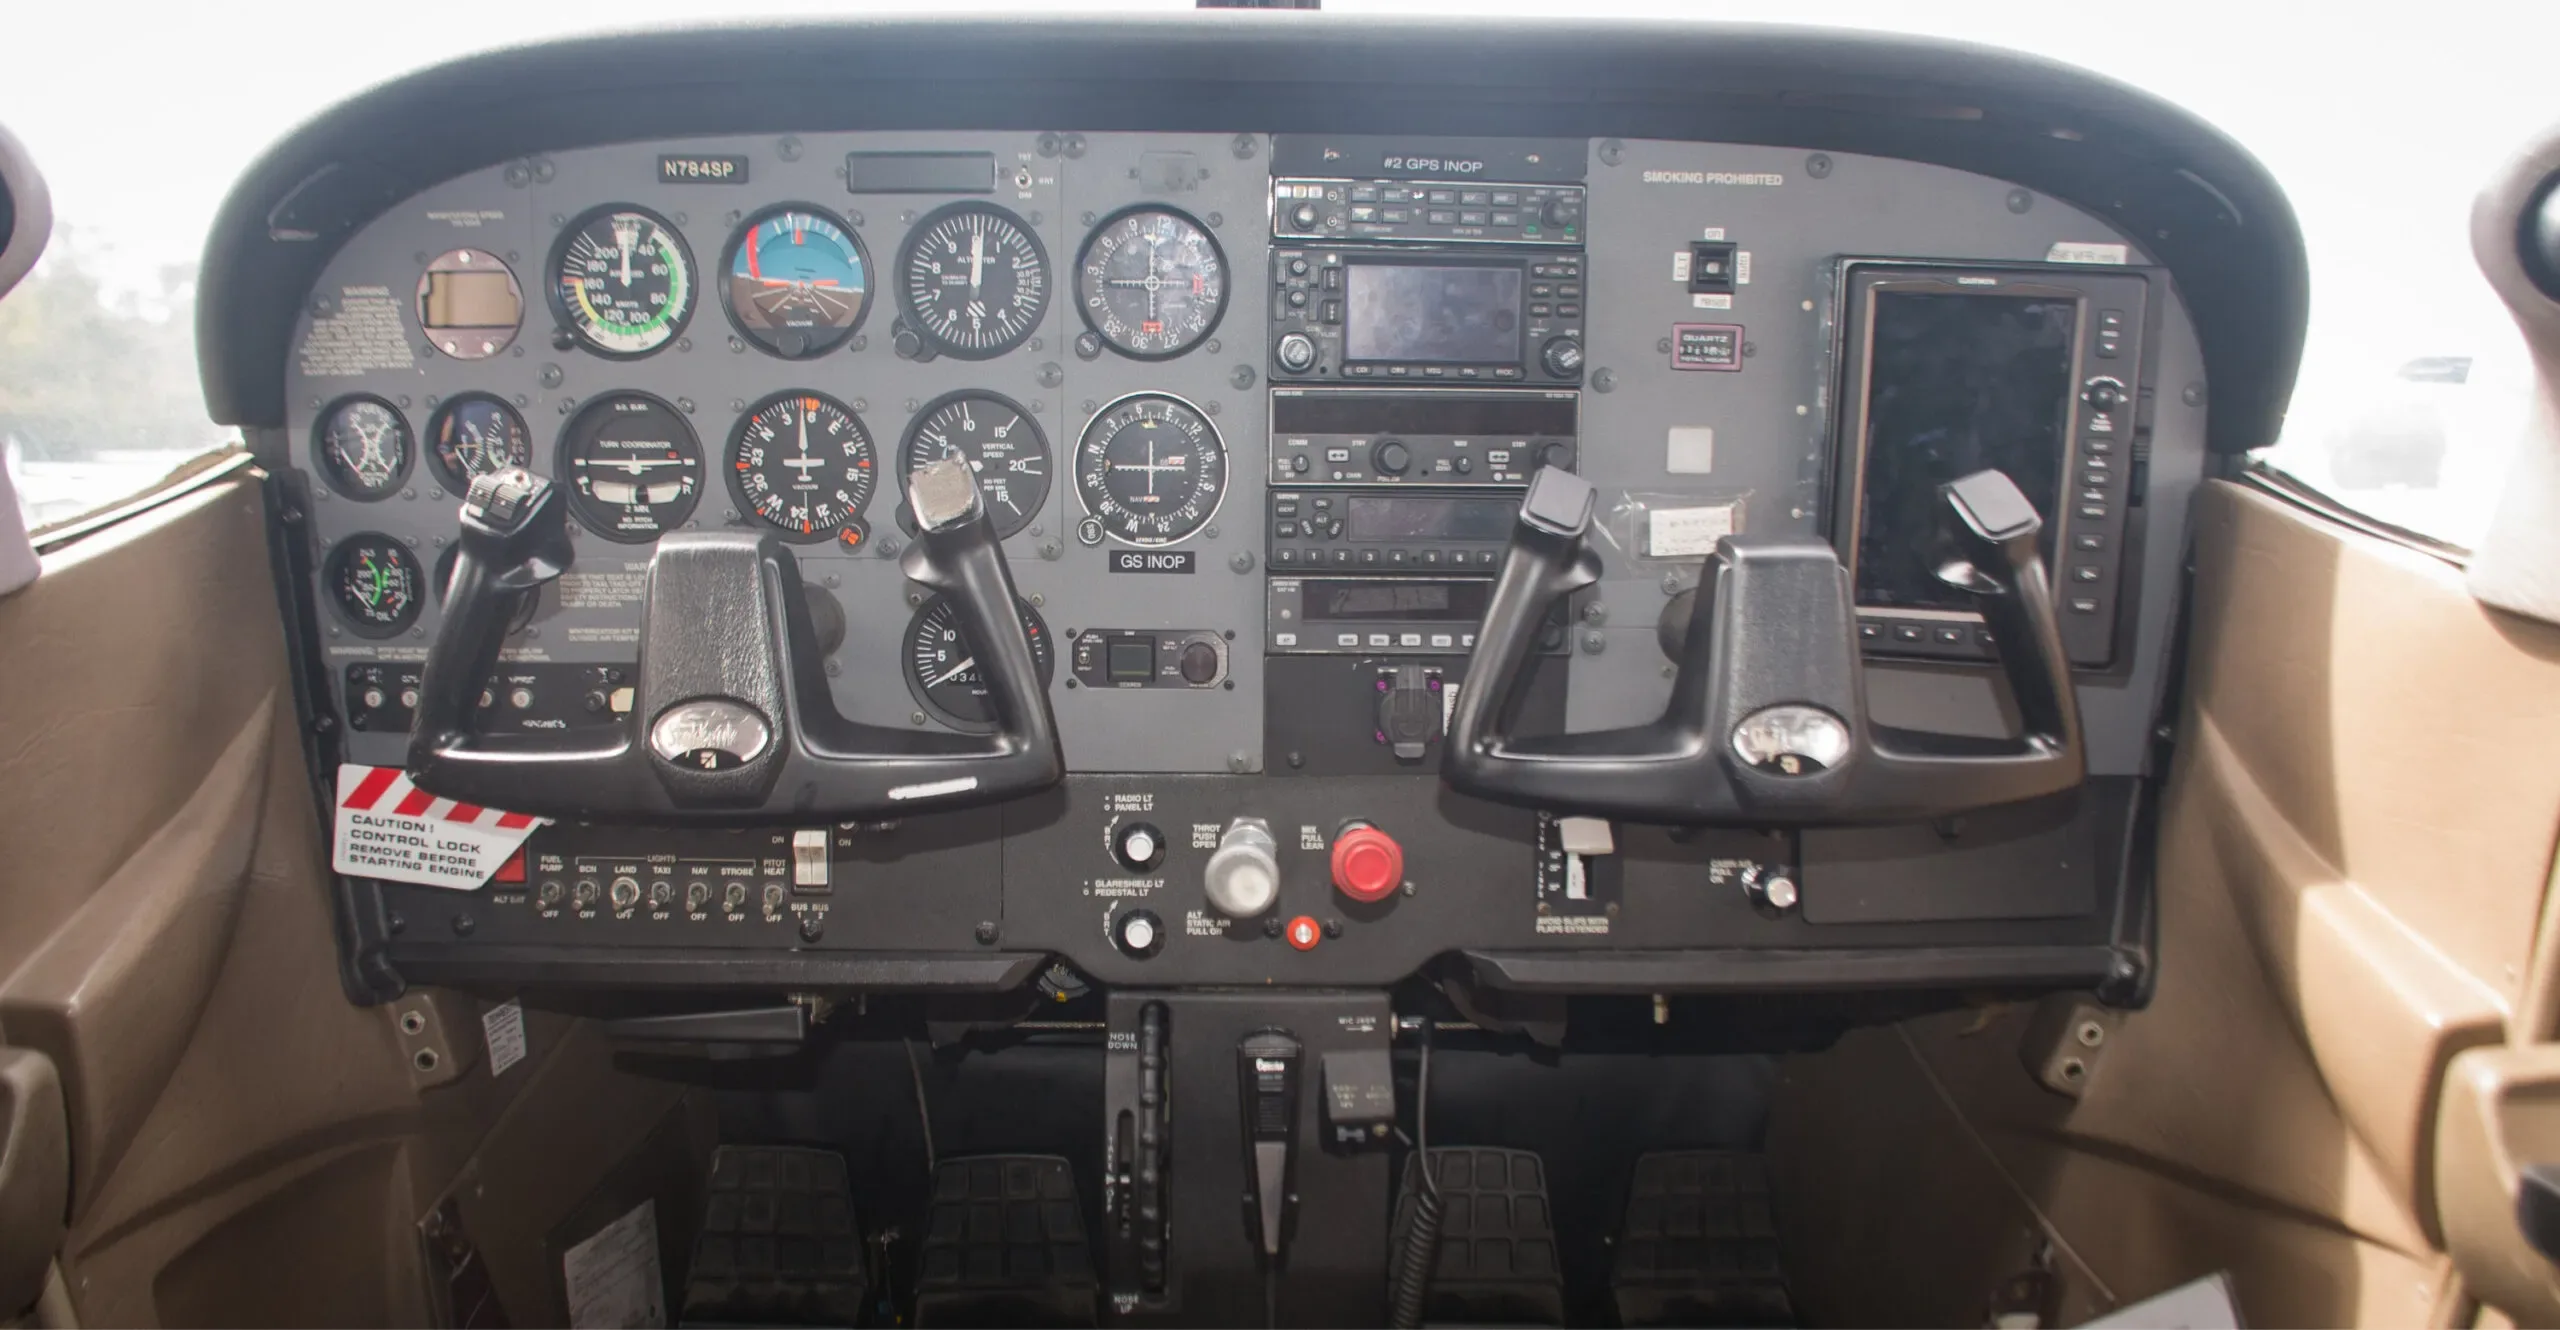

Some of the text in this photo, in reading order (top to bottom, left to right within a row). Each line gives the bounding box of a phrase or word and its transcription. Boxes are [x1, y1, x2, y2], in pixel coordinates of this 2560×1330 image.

[664, 159, 734, 178] N784SP
[1384, 158, 1483, 173] #2 GPS INOP
[1643, 171, 1783, 186] SMOKING PROHIBITED
[948, 241, 957, 254] 9
[1102, 236, 1113, 248] 6
[594, 247, 619, 259] 200
[638, 244, 656, 256] 40
[932, 262, 941, 274] 8
[1012, 256, 1021, 269] 2
[1087, 265, 1099, 276] 3
[591, 294, 612, 306] 140
[650, 292, 667, 305] 80
[932, 289, 941, 301] 7
[1013, 294, 1022, 307] 3
[603, 309, 625, 322] 120
[629, 311, 651, 323] 100
[948, 309, 957, 321] 6
[997, 308, 1006, 320] 4
[972, 317, 981, 329] 5
[1104, 320, 1121, 337] 33
[1131, 335, 1149, 349] 30
[1163, 334, 1179, 348] 27
[1683, 334, 1728, 342] QUARTZ
[1165, 404, 1175, 417] E
[782, 413, 793, 426] 3
[807, 411, 817, 423] 6
[828, 420, 842, 436] E
[963, 420, 975, 431] 10
[1106, 418, 1116, 428] 3
[1190, 421, 1202, 435] 12
[759, 426, 775, 442] N
[994, 426, 1007, 438] 15
[599, 440, 671, 448] TURN COORDINATOR
[938, 436, 947, 447] 5
[842, 441, 857, 457] 12
[1087, 443, 1100, 455] N
[750, 447, 764, 467] 33
[1205, 450, 1217, 463] 15
[1009, 460, 1026, 471] 20
[846, 467, 859, 482] 15
[752, 473, 769, 492] 30
[1086, 473, 1099, 488] 33
[582, 484, 590, 495] L
[682, 484, 692, 495] R
[1203, 482, 1215, 493] S
[835, 489, 849, 502] S
[996, 491, 1009, 502] 15
[766, 493, 783, 512] W
[1099, 500, 1114, 515] 30
[625, 505, 632, 513] 2
[790, 505, 808, 520] 24
[815, 503, 830, 518] 21
[1185, 507, 1198, 520] 21
[1125, 519, 1139, 533] W
[1157, 521, 1170, 532] 24
[1120, 554, 1186, 569] GS INOP
[1283, 552, 1289, 560] 0
[1312, 552, 1316, 560] 1
[1339, 553, 1345, 561] 2
[1367, 553, 1373, 561] 3
[1394, 553, 1400, 561] 4
[1429, 554, 1435, 562] 5
[1456, 554, 1463, 562] 6
[1484, 554, 1491, 562] 7
[943, 630, 956, 641] 10
[937, 649, 947, 661] 5
[1115, 794, 1153, 803] RADIO LT
[1115, 803, 1153, 811] PANEL LT
[1192, 824, 1221, 833] THROT
[1301, 826, 1317, 834] MIX
[351, 829, 481, 854] CONTROL LOCK
[1192, 832, 1216, 840] PUSH
[1301, 834, 1323, 842] PULL
[1301, 842, 1324, 850] LEAN
[350, 843, 476, 867] REMOVE BEFORE
[541, 855, 562, 864] FUEL
[647, 855, 676, 863] LIGHTS
[349, 854, 485, 879] STARTING ENGINE
[540, 863, 563, 872] PUMP
[763, 859, 786, 867] PITOT
[579, 865, 597, 873] BCN
[614, 865, 637, 874] LAND
[653, 867, 671, 875] TAXI
[691, 867, 709, 875] NAV
[721, 868, 754, 876] STROBE
[764, 867, 785, 876] HEAT
[1095, 879, 1164, 888] GLARESHIELD LT
[1095, 888, 1149, 897] PEDESTAL LT
[791, 903, 829, 912] BUS BUS
[543, 910, 559, 918] OFF
[580, 911, 596, 919] OFF
[616, 911, 632, 919] OFF
[653, 912, 670, 920] OFF
[690, 913, 708, 921] OFF
[728, 913, 745, 922] OFF
[766, 914, 783, 922] OFF
[818, 911, 824, 919] 2
[1186, 911, 1203, 919] ALT
[1186, 919, 1231, 928] STATIC AIR
[1536, 925, 1609, 933] FLAPS EXTENDED
[1186, 927, 1222, 935] PULL ON
[1109, 1032, 1136, 1042] NOSE
[1108, 1041, 1138, 1050] DOWN
[1114, 1295, 1139, 1304] NOSE
[1120, 1304, 1132, 1314] UP
